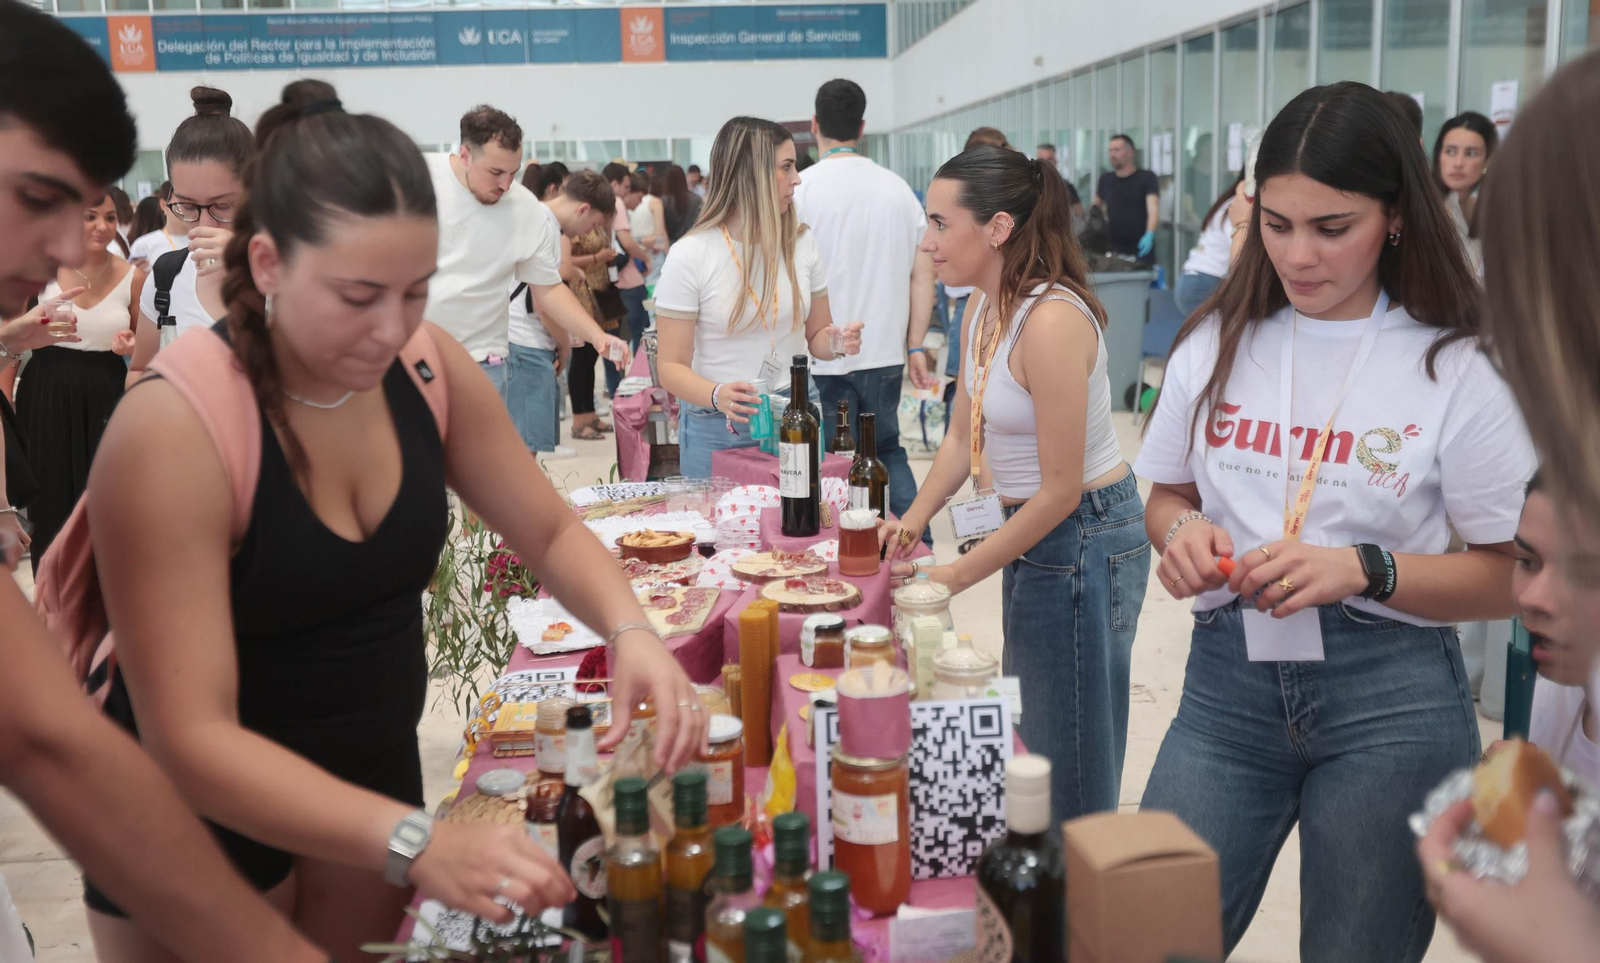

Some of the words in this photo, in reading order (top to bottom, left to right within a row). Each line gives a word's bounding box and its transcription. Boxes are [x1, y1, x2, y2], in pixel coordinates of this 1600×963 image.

[157, 38, 225, 54] Delegación
[228, 38, 247, 51] del
[250, 37, 290, 51] Rector
[294, 39, 322, 54] para
[324, 37, 336, 50] la
[338, 35, 435, 51] Implementación
[489, 29, 523, 45] UCA
[669, 32, 734, 46] Inspección
[737, 30, 785, 44] General
[787, 31, 804, 43] de
[805, 29, 861, 43] Servicios
[205, 52, 221, 64] de
[278, 52, 294, 63] de
[297, 51, 349, 66] Igualdad
[351, 54, 359, 65] y
[362, 51, 379, 62] de
[381, 49, 436, 61] Inclusión
[1218, 461, 1241, 472] Que
[1245, 466, 1261, 475] no
[1266, 470, 1279, 479] te
[1316, 476, 1329, 486] de
[1332, 477, 1348, 488] ná
[1385, 567, 1394, 592] MALU
